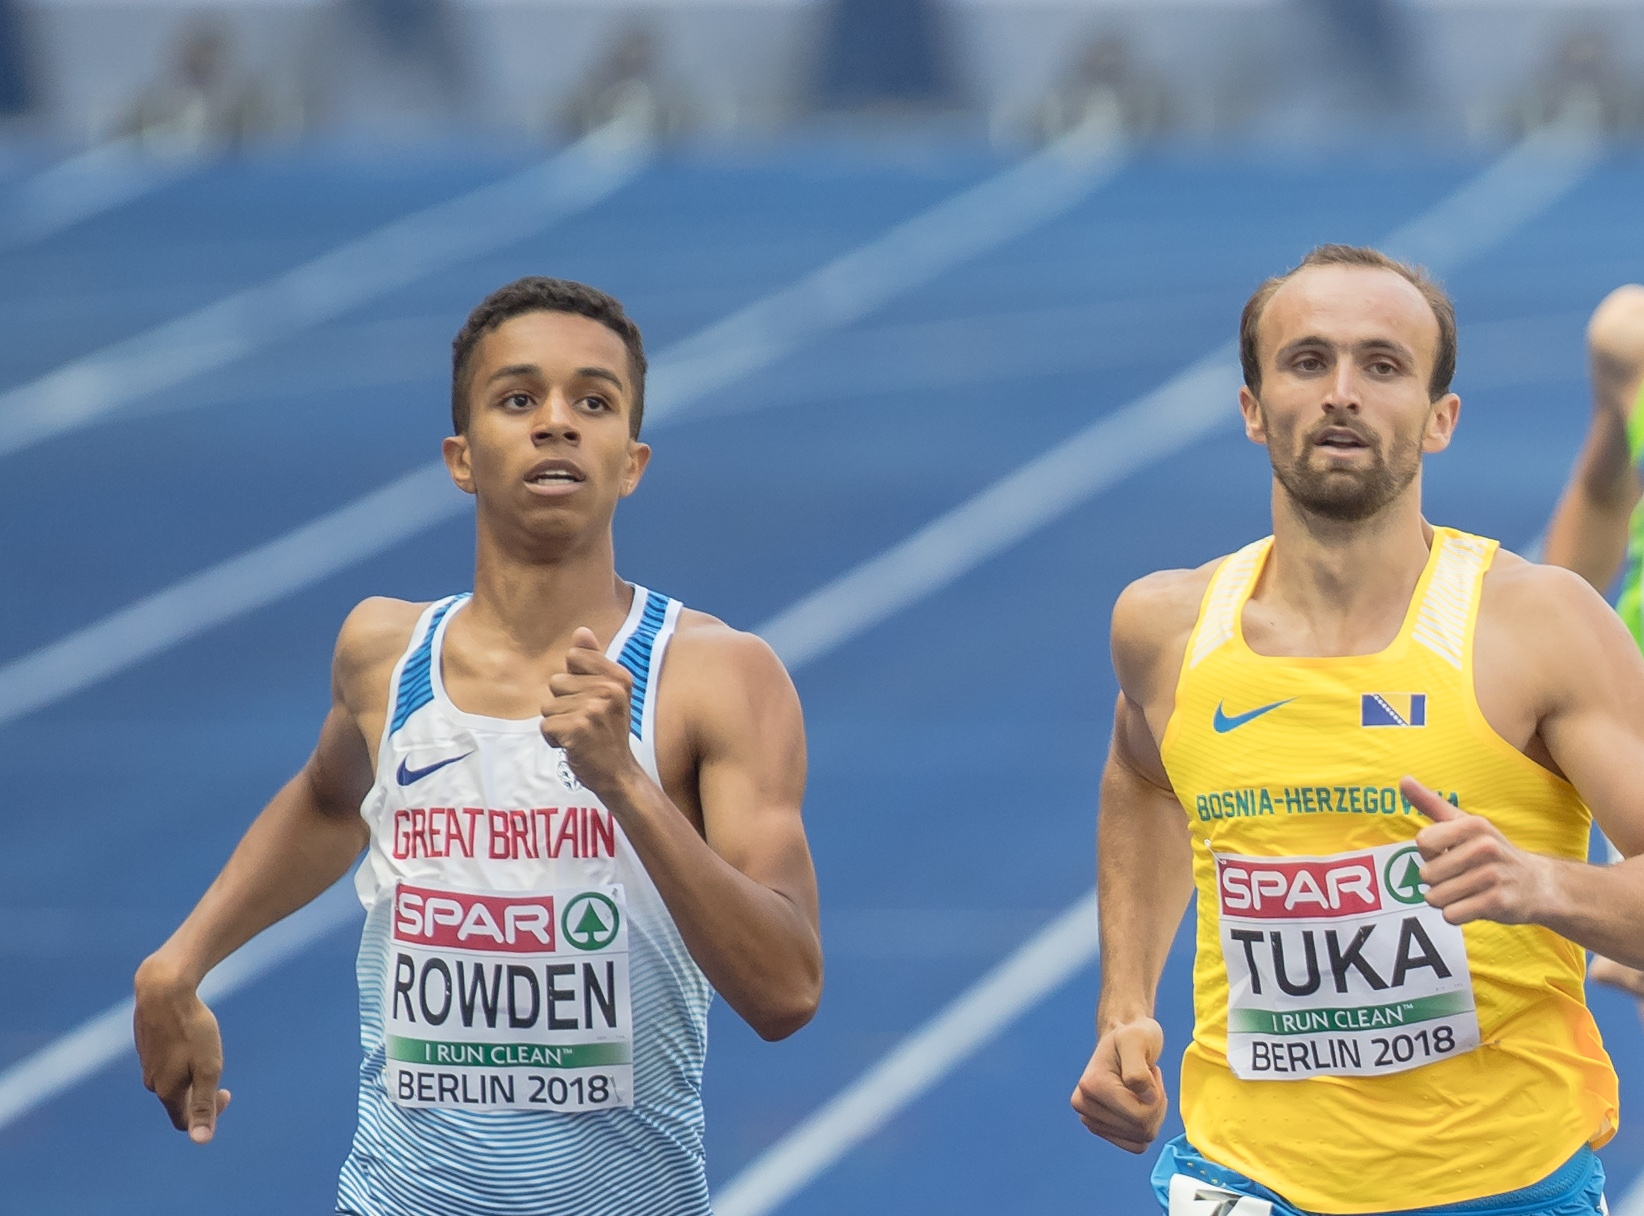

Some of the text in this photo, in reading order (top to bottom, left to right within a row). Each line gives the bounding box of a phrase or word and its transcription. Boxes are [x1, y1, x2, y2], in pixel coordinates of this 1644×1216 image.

[1196, 786, 1458, 822] BOSNIA-HERZEGOV
[392, 806, 616, 860] GREAT BRITAIN
[1222, 865, 1376, 912] SPAR
[396, 891, 552, 945] SPAR
[1230, 915, 1453, 998] TUKA
[392, 952, 617, 1031] ROWDEN
[1271, 1013, 1278, 1033] I
[1283, 1011, 1330, 1033] RUN
[424, 1042, 431, 1061] I
[437, 1043, 485, 1064] RUN
[1251, 1024, 1456, 1073] BERLIN 2018
[398, 1069, 610, 1105] BERLIN 2018
